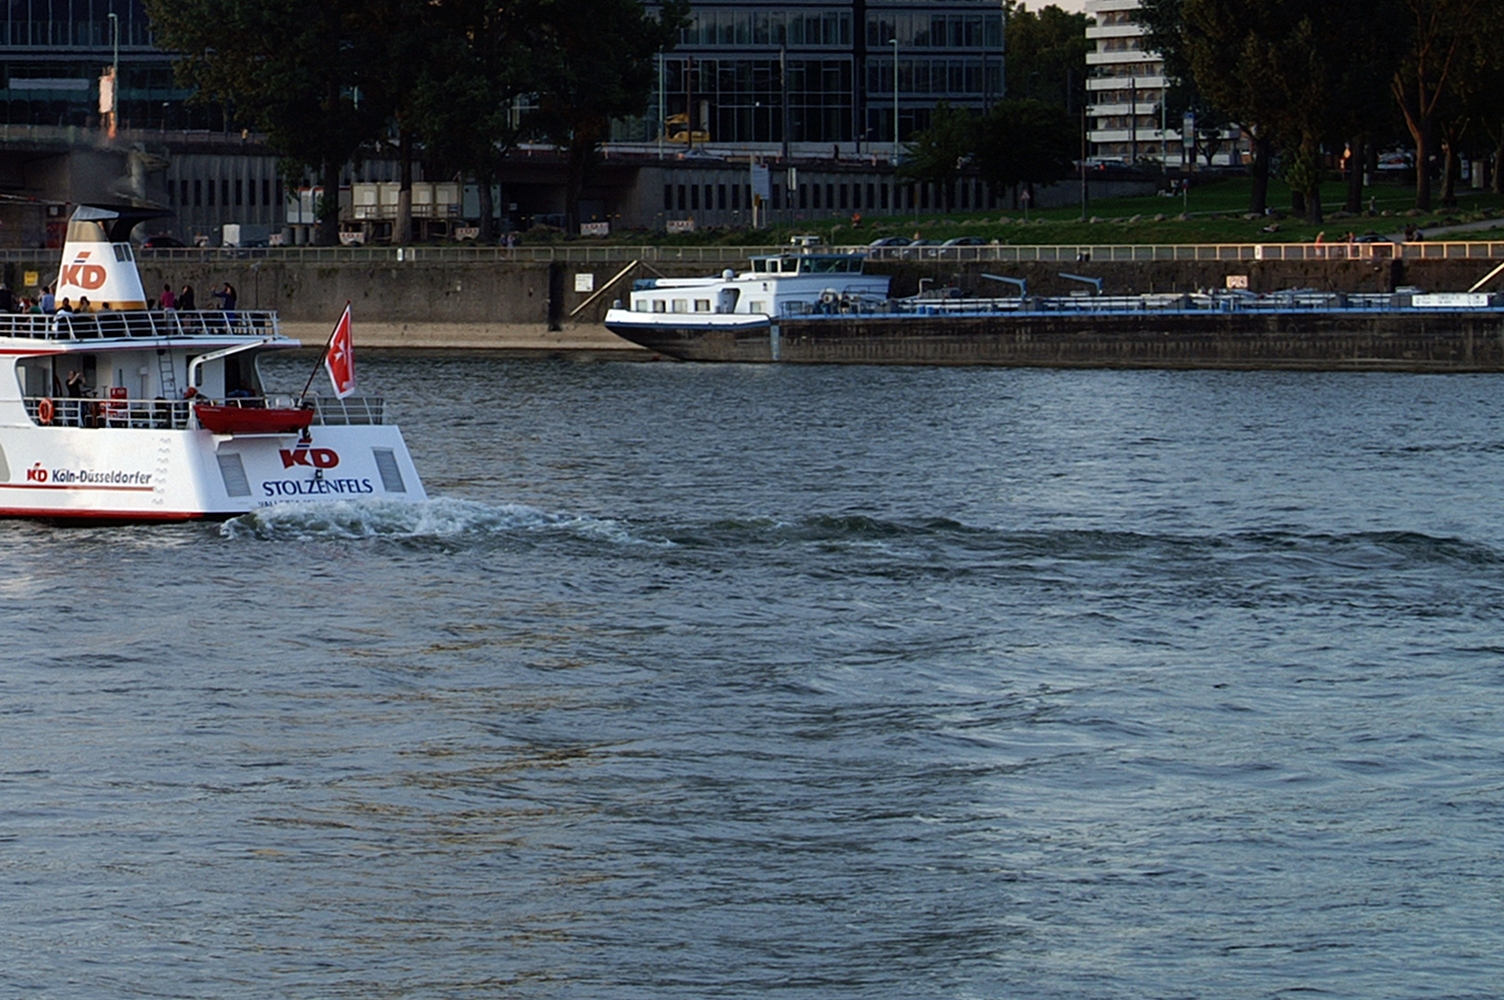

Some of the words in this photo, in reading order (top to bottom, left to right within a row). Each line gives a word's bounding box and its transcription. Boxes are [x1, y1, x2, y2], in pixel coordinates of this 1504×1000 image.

[60, 264, 107, 290] KD
[278, 448, 340, 469] KD
[52, 468, 152, 484] Köln-Düsseldorfer
[262, 478, 374, 497] STOLZENFELS
